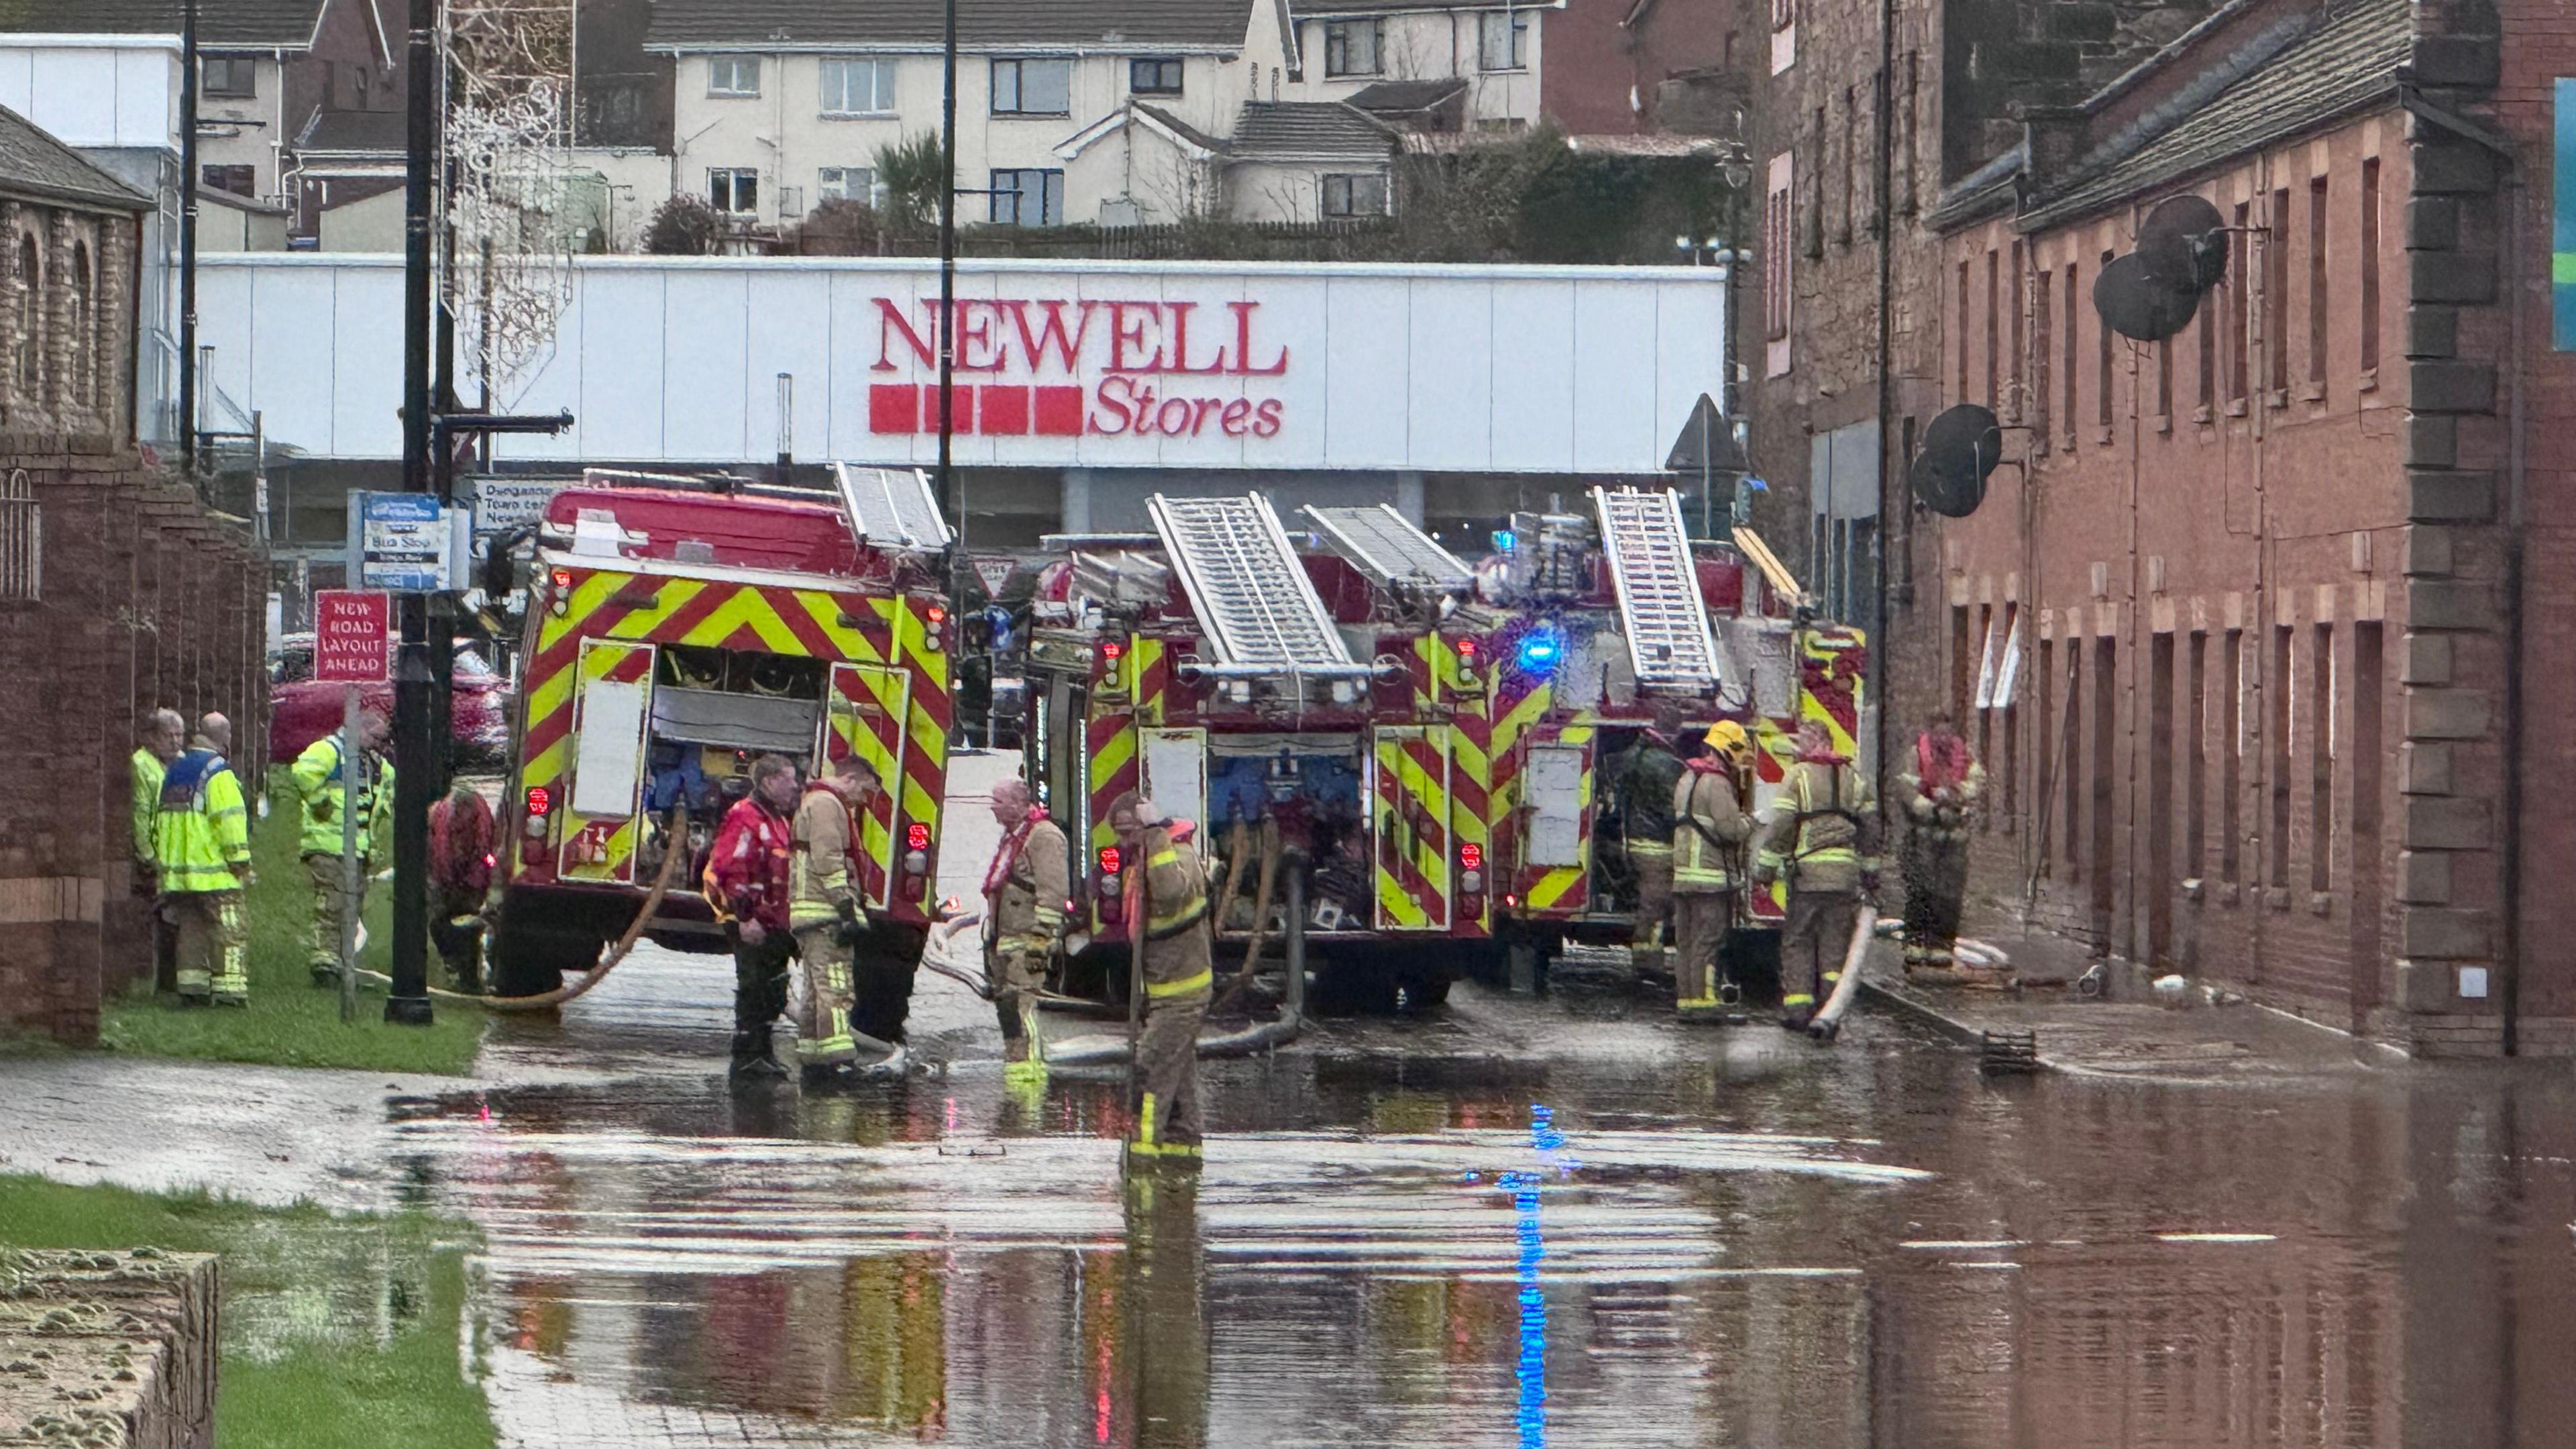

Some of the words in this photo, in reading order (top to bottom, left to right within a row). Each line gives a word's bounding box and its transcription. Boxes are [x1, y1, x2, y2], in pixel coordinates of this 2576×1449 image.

[869, 298, 1287, 376] NEWELL
[1088, 375, 1284, 439] Stores
[333, 602, 372, 616] NEW
[330, 620, 374, 634] ROAD
[322, 637, 381, 654] LAYOUT
[325, 658, 380, 672] AHEAD
